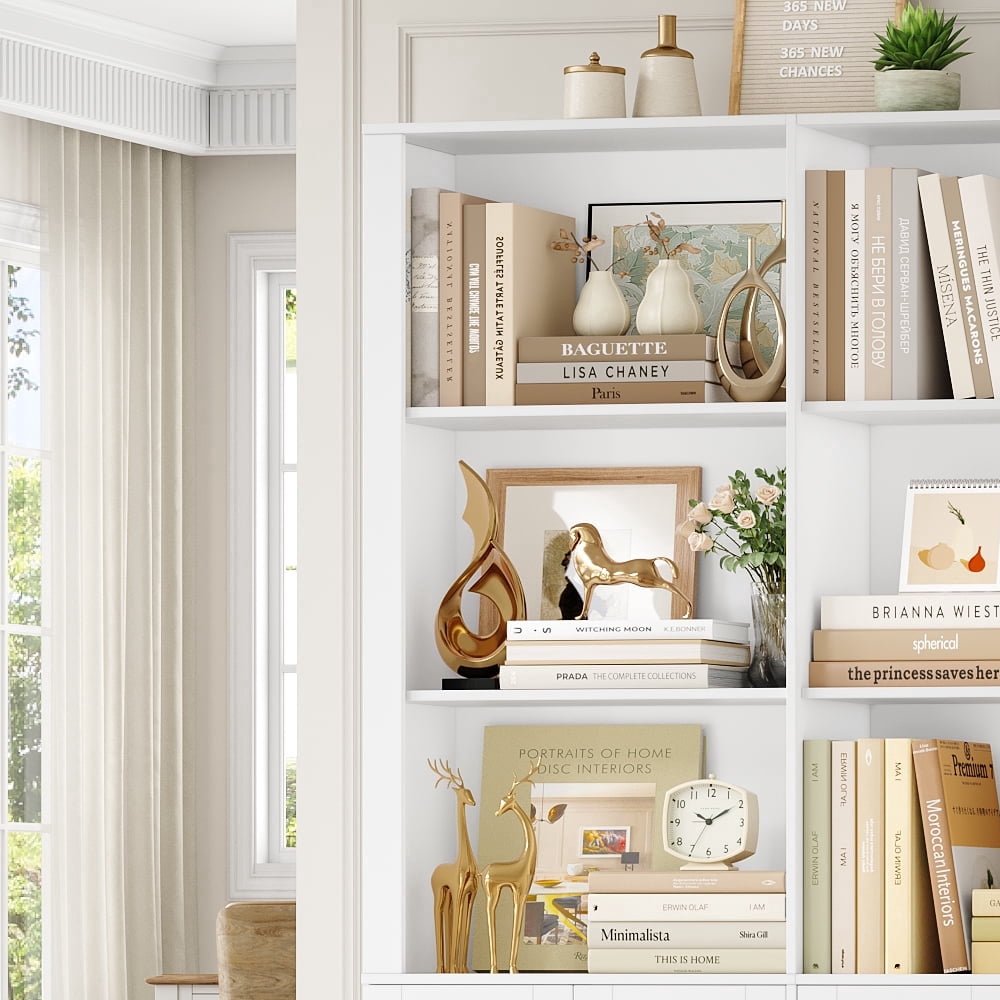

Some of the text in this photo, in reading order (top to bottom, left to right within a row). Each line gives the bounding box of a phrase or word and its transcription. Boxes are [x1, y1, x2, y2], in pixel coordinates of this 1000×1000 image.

[784, 0, 847, 12] 365 NEW
[783, 20, 818, 31] DAYS
[781, 46, 844, 59] 365 NEW
[780, 65, 843, 78] CHANCES
[850, 214, 859, 245] МОГУ
[899, 217, 910, 254] ДАВИД
[872, 236, 885, 254] НЕ
[976, 244, 989, 266] THE
[872, 258, 885, 294] БЕРИ
[980, 269, 993, 295] THIN
[850, 249, 859, 318] ОБЪЯСНИТЬ
[952, 220, 983, 365] MERINGUES MACARONS
[872, 298, 885, 308] В
[850, 321, 859, 369] МНОГОЕ
[872, 311, 885, 369] ГОЛОВУ
[561, 341, 667, 357] BAGUETTE
[563, 364, 670, 379] LISA CHANEY
[591, 386, 621, 400] Paris
[872, 605, 1000, 619] BRIANNA WIEST
[912, 633, 959, 654] spherical
[593, 672, 607, 680] THE
[607, 672, 646, 680] COMPLETE
[647, 672, 697, 680] COLLECTIONS
[848, 666, 871, 681] the
[873, 666, 933, 684] princess
[935, 669, 974, 680] saves
[519, 748, 672, 759] PORTRAITS OF HOME
[537, 763, 652, 774] DISC INTERIORS
[811, 762, 819, 777] AM
[690, 791, 698, 800] 11
[707, 788, 717, 798] 12
[676, 800, 686, 808] 10
[738, 799, 744, 808] 2
[675, 818, 680, 827] 9
[739, 818, 744, 827] 3
[676, 837, 683, 846] 8
[736, 837, 742, 846] 4
[811, 831, 819, 855] OLAF
[690, 845, 695, 853] 7
[706, 848, 712, 856] 6
[724, 845, 729, 854] 5
[926, 798, 954, 927] Moroccan Interiors
[811, 856, 819, 886] ERWIN
[754, 903, 765, 911] AM
[601, 928, 768, 942] Minimalista Shira Gill
[655, 955, 720, 964] THIS IS HOME
